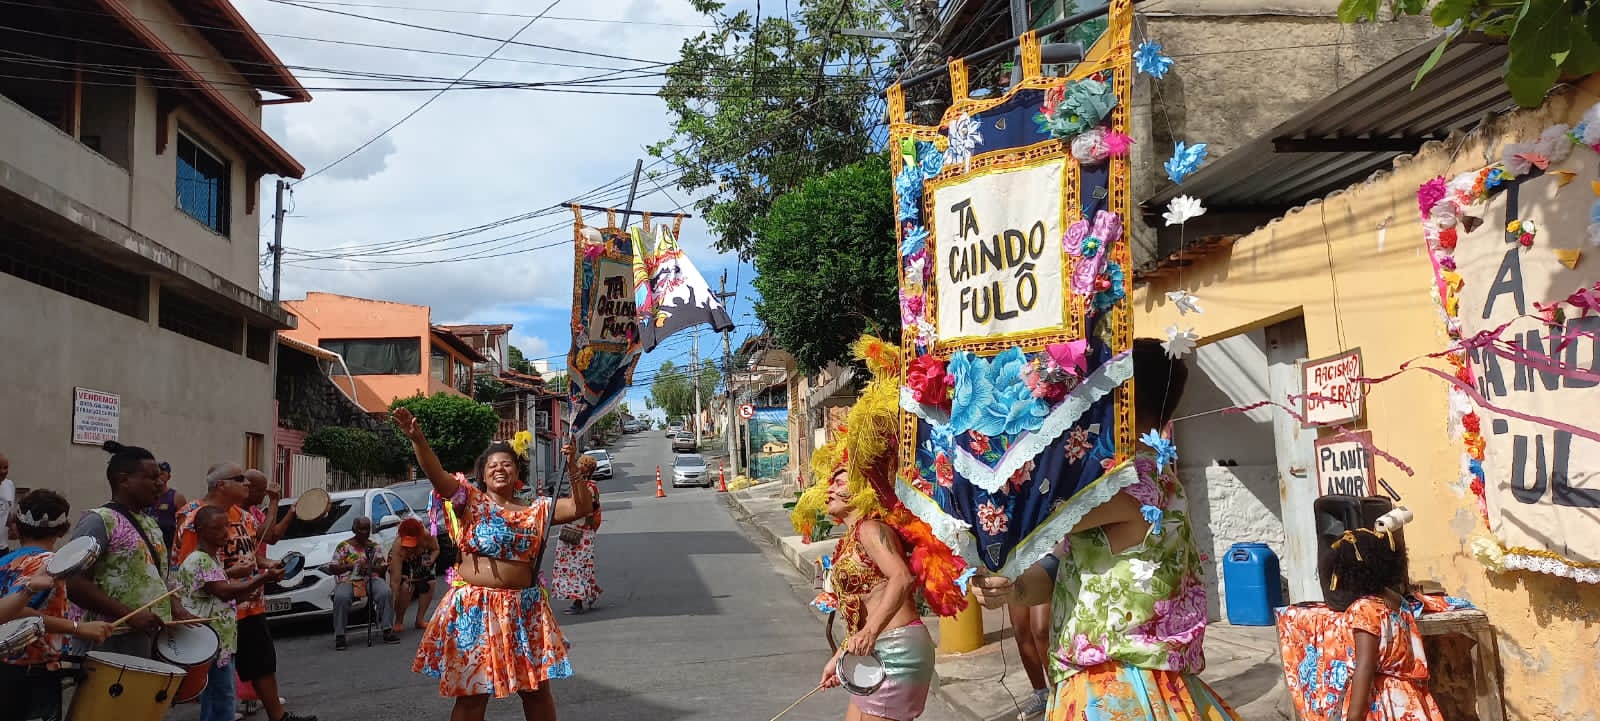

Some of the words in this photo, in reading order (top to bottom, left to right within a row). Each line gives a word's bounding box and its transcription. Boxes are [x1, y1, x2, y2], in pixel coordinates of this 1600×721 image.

[950, 197, 980, 241] TA
[948, 220, 1046, 284] CAINDO
[960, 262, 1038, 332] FULÔ
[1315, 355, 1358, 387] RACISMO?
[78, 391, 118, 404] VENDEMOS
[1320, 447, 1370, 472] PLANTE
[1327, 475, 1365, 496] AMOR
